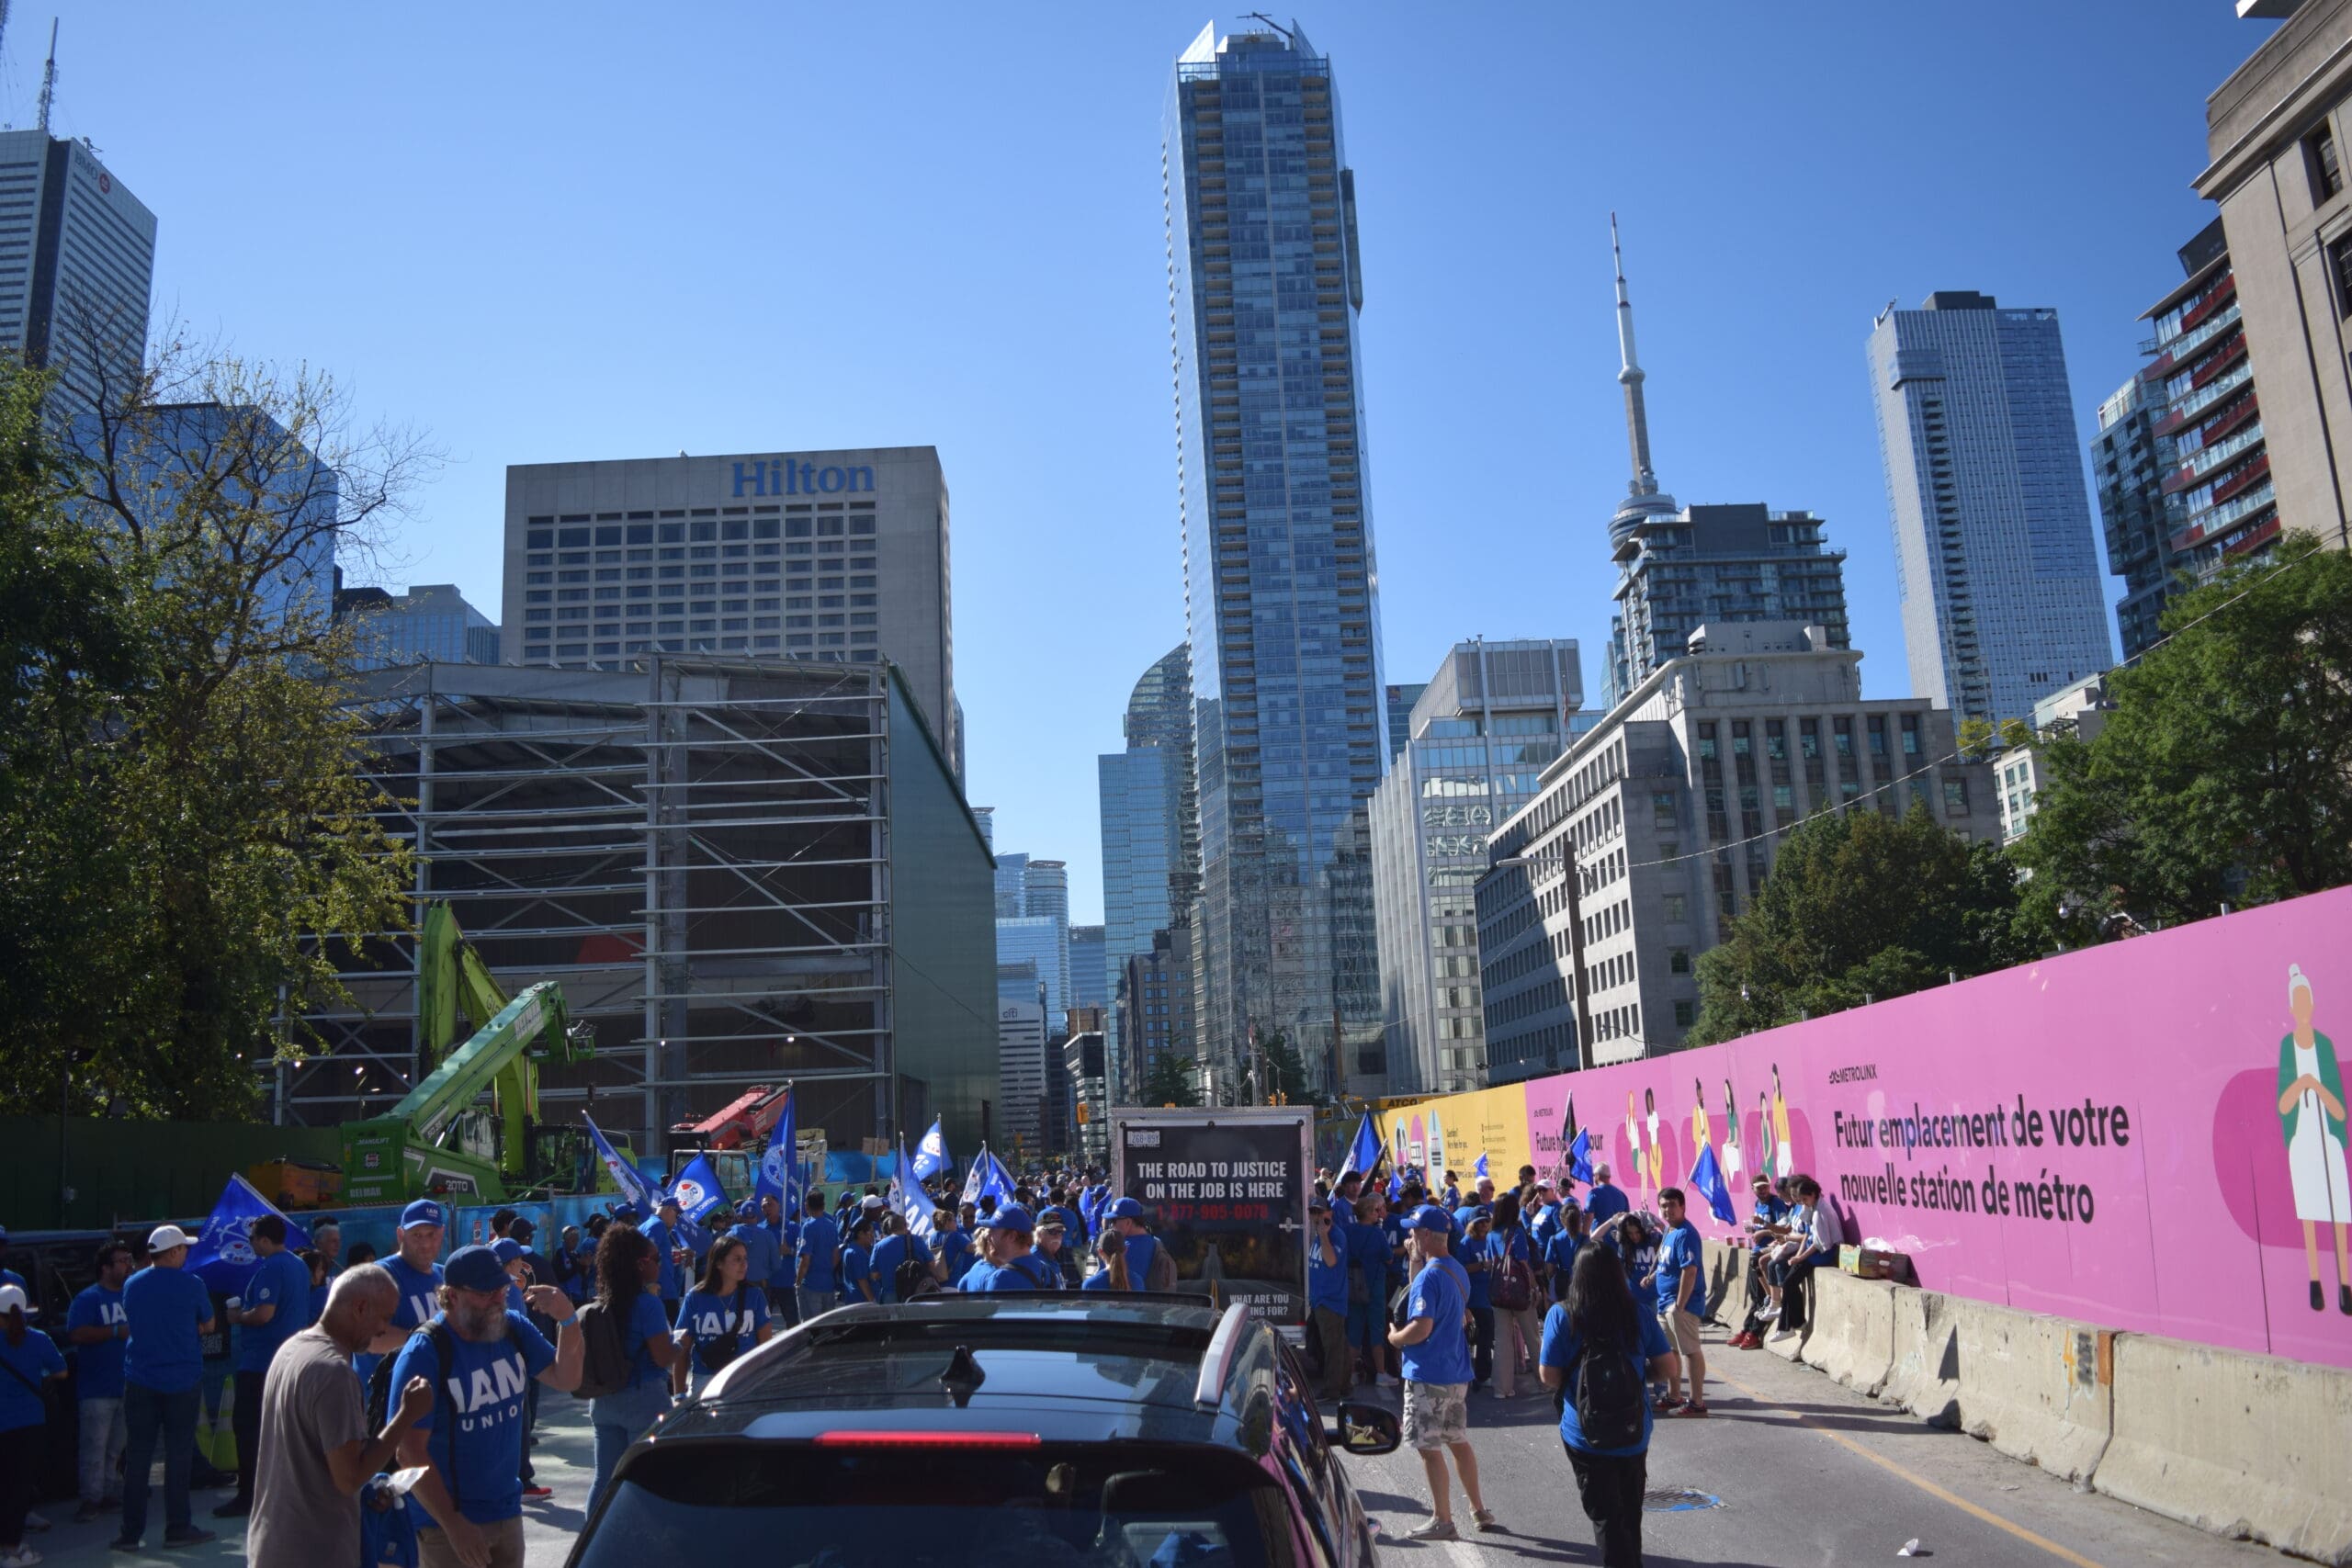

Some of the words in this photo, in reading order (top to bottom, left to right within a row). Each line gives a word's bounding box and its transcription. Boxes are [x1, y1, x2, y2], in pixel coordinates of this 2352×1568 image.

[732, 458, 876, 497] Hilton
[1839, 1064, 1878, 1083] METROLINX
[1387, 1098, 1418, 1108] ATCO
[1834, 1111, 1874, 1148] Futur
[1879, 1102, 2007, 1161] emplacement
[2011, 1093, 2043, 1147] de
[2049, 1098, 2130, 1147] votre
[1535, 1132, 1555, 1151] Future
[1137, 1162, 1163, 1178] THE
[1168, 1162, 1206, 1178] ROAD
[1210, 1162, 1228, 1177] TO
[1232, 1161, 1286, 1177] JUSTICE
[1146, 1183, 1165, 1199] ON
[1170, 1183, 1195, 1198] THE
[1199, 1182, 1226, 1198] JOB
[1229, 1182, 1244, 1198] IS
[1248, 1182, 1283, 1197] HERE
[1840, 1162, 1906, 1207] nouvelle
[1910, 1165, 1976, 1213] station
[1982, 1165, 2010, 1216] de
[2014, 1168, 2094, 1224] métro
[1229, 1294, 1251, 1304] WHAT
[1254, 1294, 1271, 1303] ARE
[1272, 1294, 1290, 1303] YOU
[100, 1302, 129, 1325] IA
[1268, 1306, 1288, 1316] FOR?
[461, 1398, 525, 1431] UNIO
